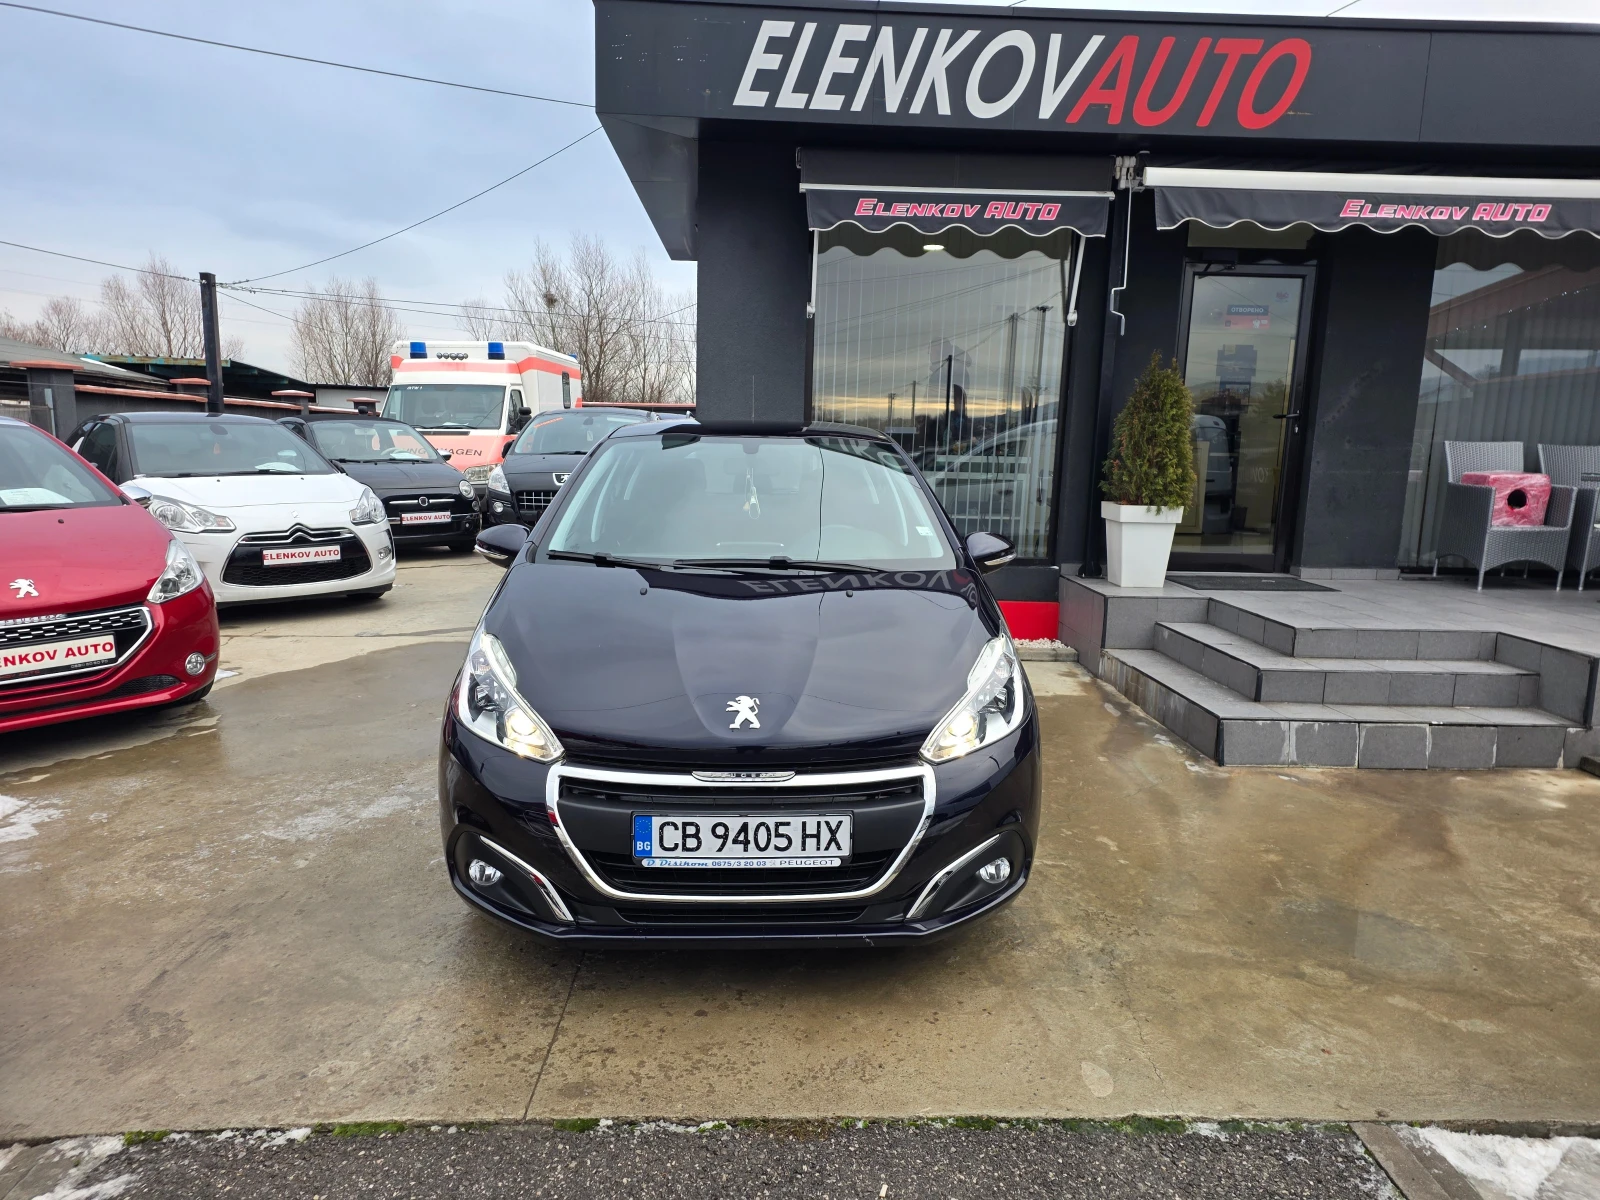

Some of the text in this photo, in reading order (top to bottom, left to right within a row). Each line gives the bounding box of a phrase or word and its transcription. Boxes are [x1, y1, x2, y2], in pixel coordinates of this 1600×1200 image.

[733, 20, 1312, 130] ELENKOV AUTO
[984, 201, 1062, 221] AUTO
[1472, 202, 1553, 222] AUTO
[263, 549, 340, 561] ELENKOV AUTO
[0, 649, 58, 668] NKOV
[64, 641, 114, 659] AUTO
[636, 841, 651, 851] BG
[658, 820, 844, 852] CB 9405 HX
